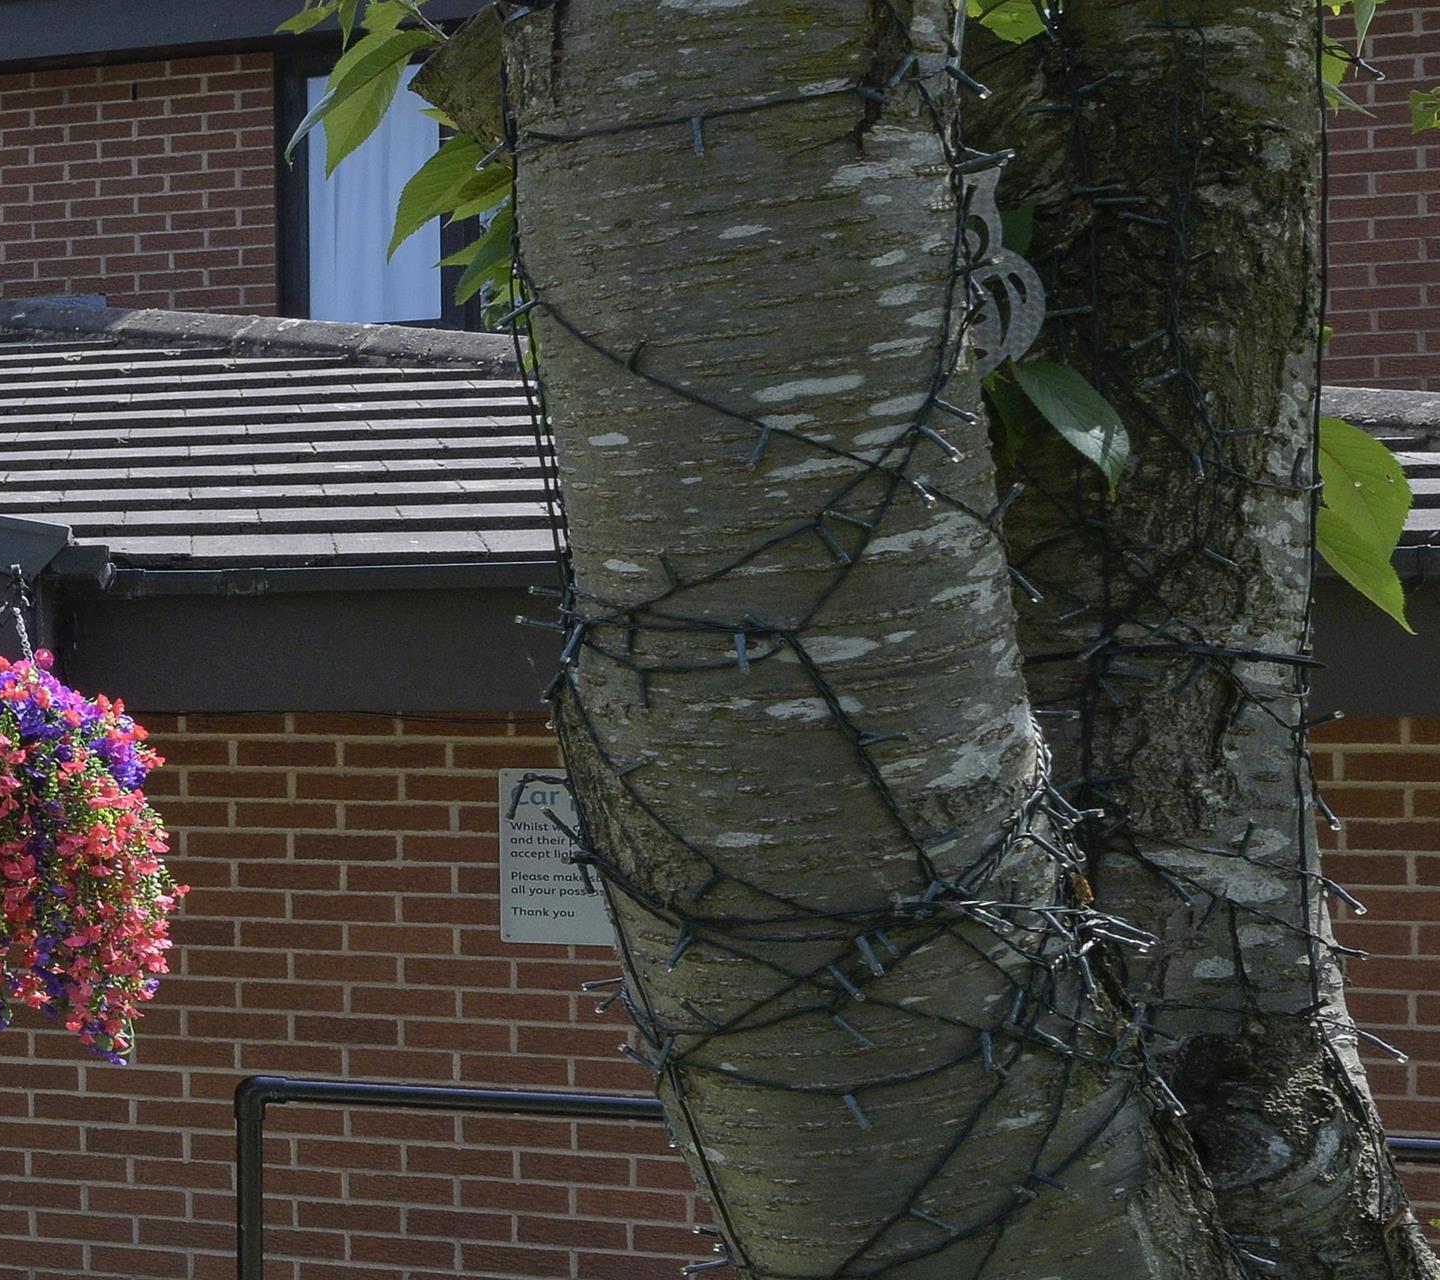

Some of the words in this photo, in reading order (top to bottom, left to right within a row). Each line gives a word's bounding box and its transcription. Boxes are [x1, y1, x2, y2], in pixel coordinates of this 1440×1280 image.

[511, 822, 548, 831] Whilst
[510, 835, 533, 845] and
[537, 836, 566, 845] their
[510, 850, 550, 860] accept
[511, 871, 550, 881] Please
[511, 885, 525, 894] all
[529, 887, 556, 897] your
[511, 907, 549, 917] Thank
[552, 909, 575, 919] you
